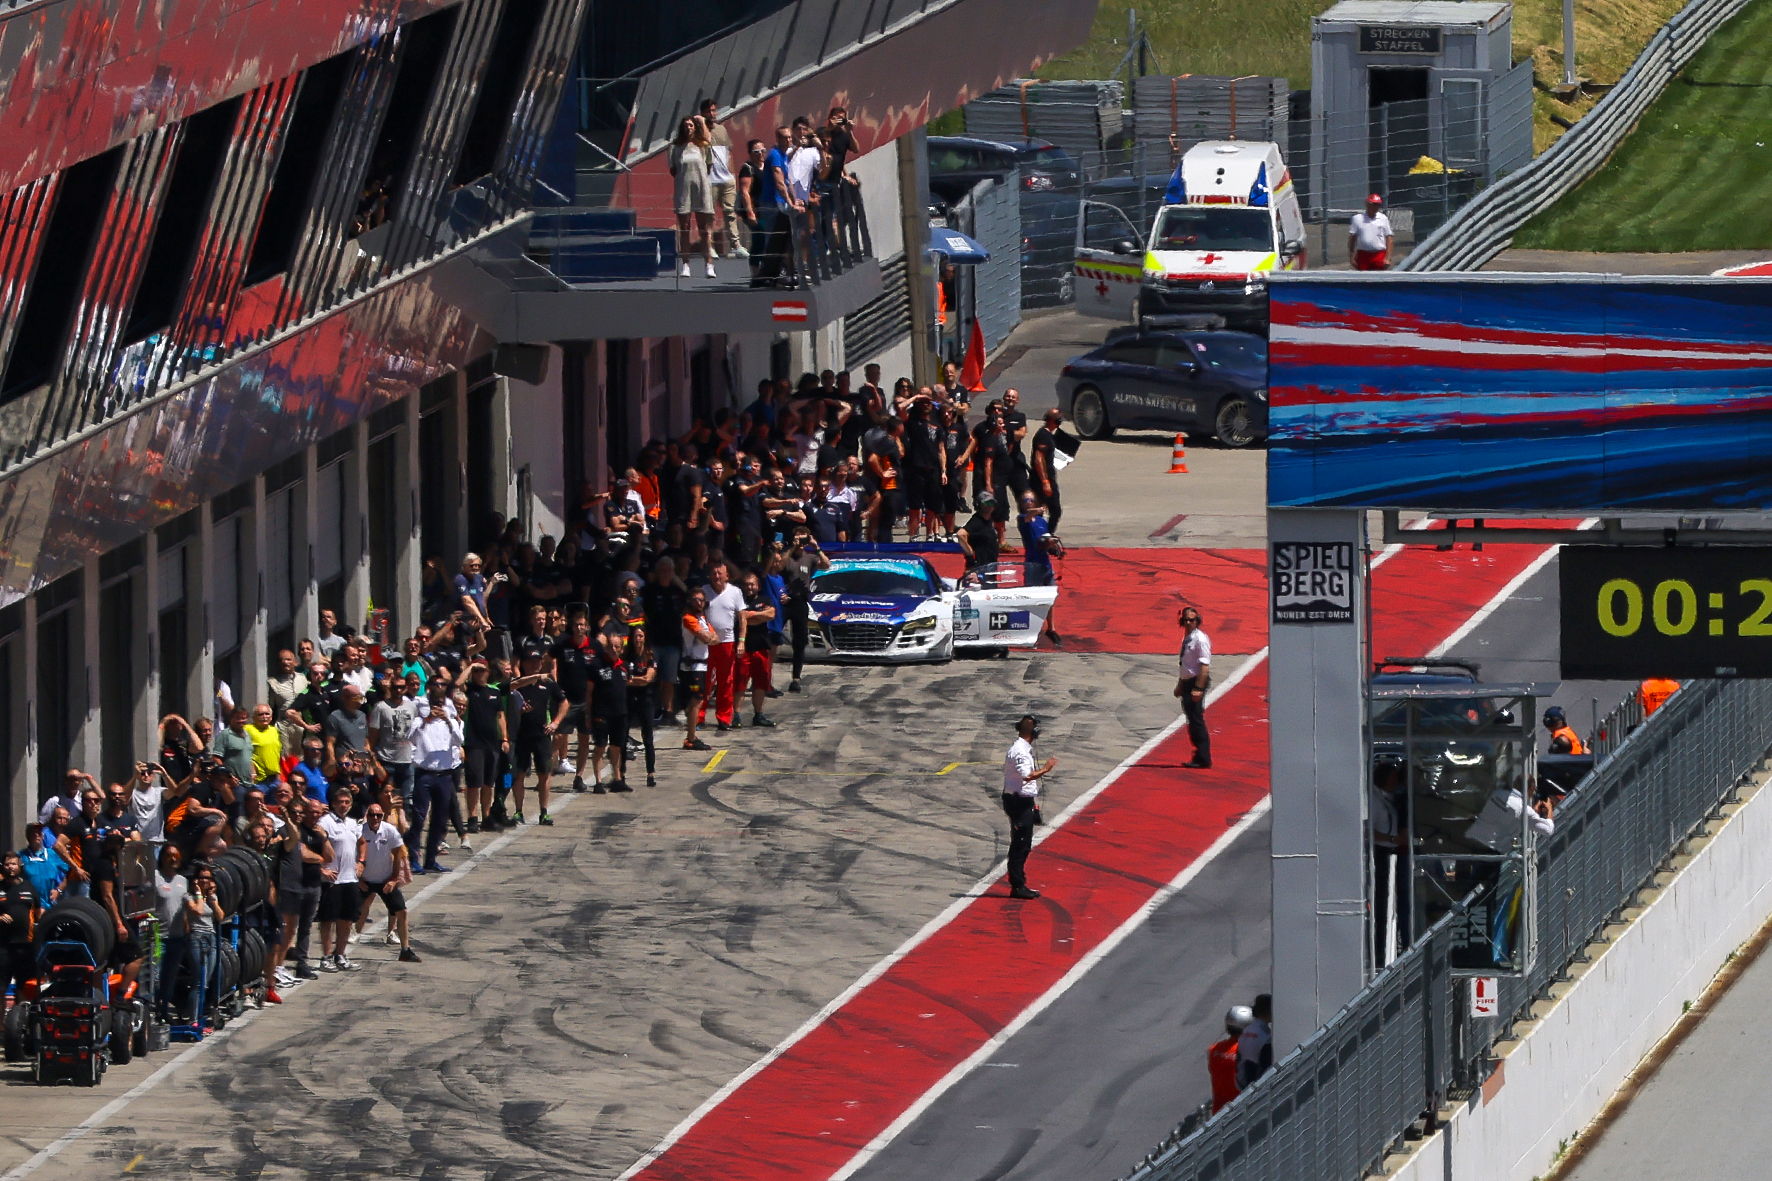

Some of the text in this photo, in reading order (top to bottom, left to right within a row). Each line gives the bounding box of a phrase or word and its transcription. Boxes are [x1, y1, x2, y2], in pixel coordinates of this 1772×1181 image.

[1369, 28, 1431, 39] STRECKEN
[1374, 40, 1425, 51] STAFFEL
[1275, 544, 1351, 571] SPIEL
[1275, 570, 1345, 597] BERG
[1328, 610, 1351, 619] OMEN
